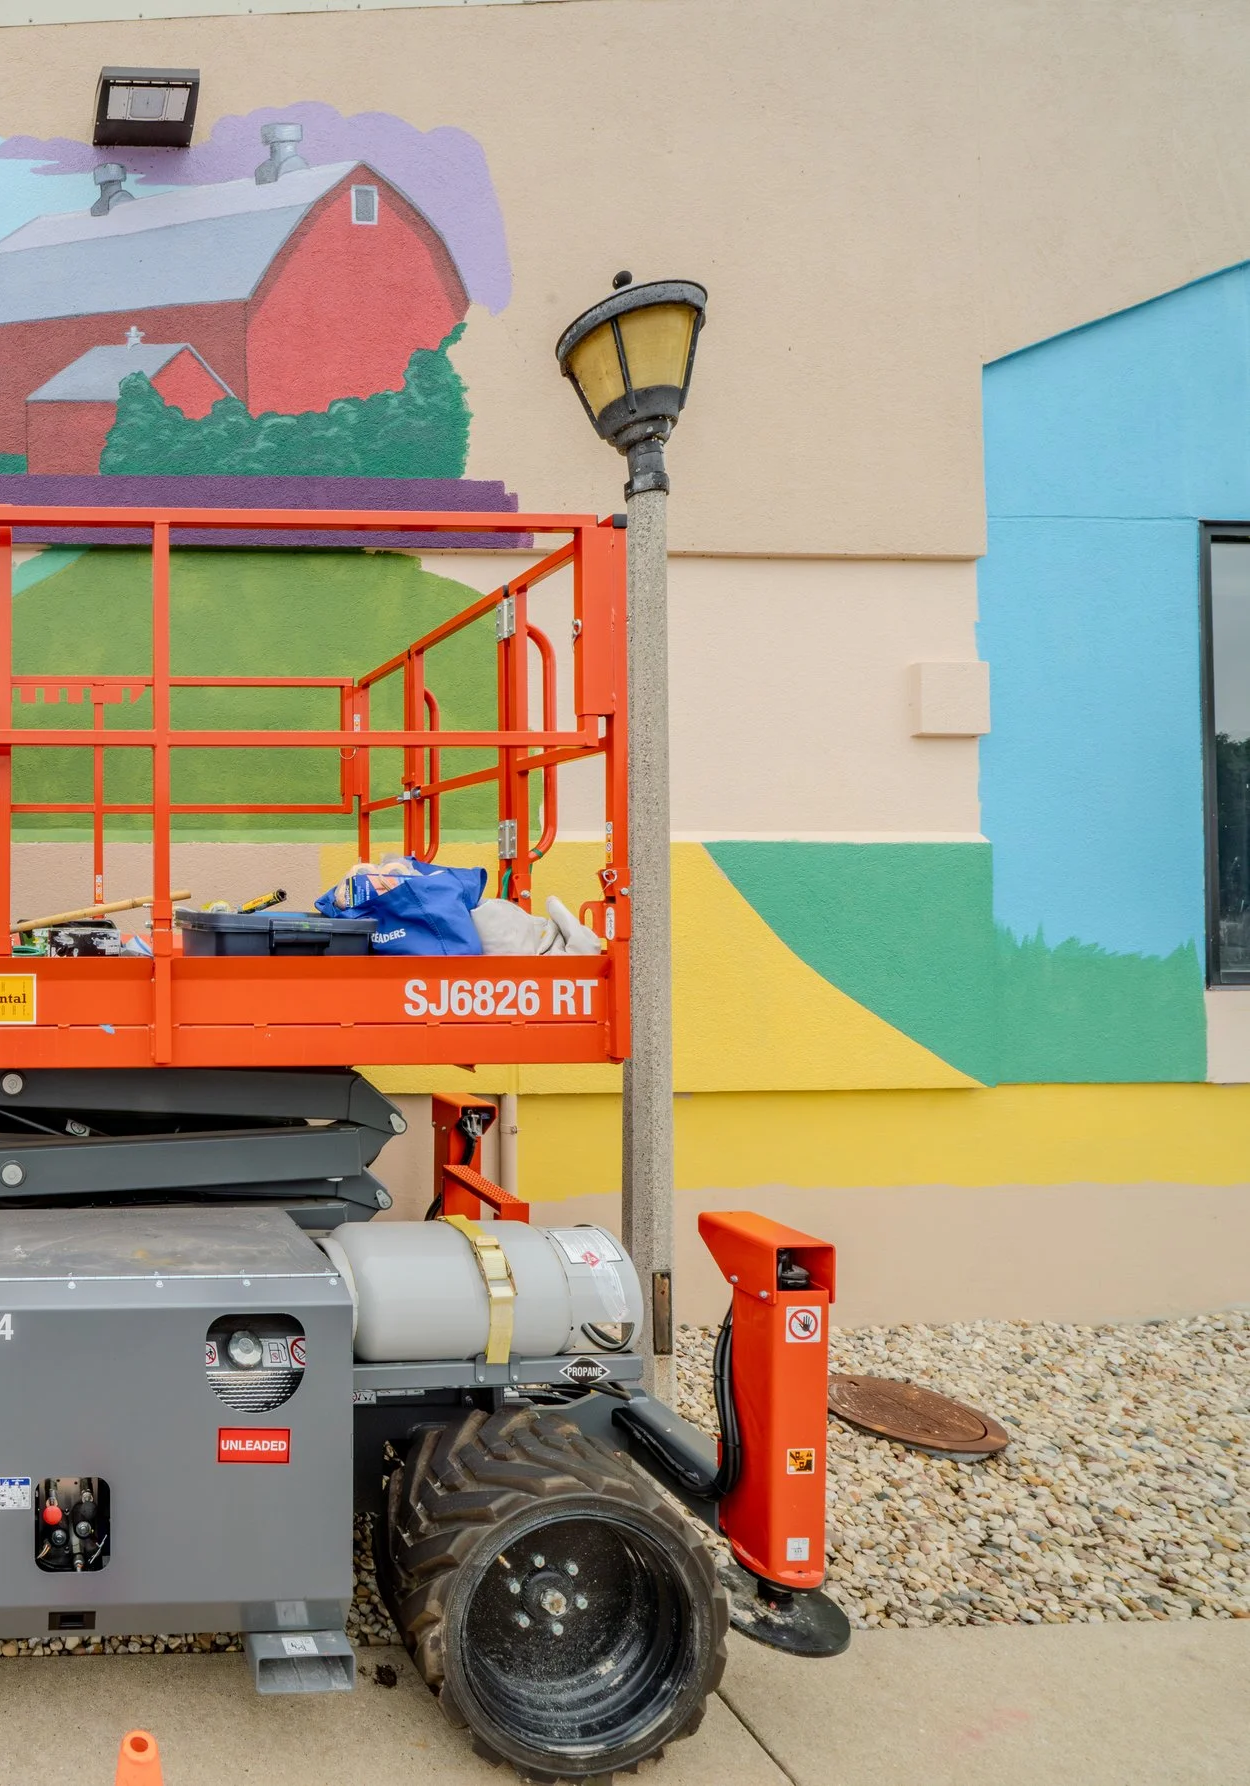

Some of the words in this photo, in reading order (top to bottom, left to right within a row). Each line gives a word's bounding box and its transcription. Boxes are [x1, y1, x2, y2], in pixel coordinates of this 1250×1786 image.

[404, 979, 540, 1016] SJ6826
[552, 979, 598, 1015] RT
[567, 1366, 603, 1377] PROPANE
[221, 1439, 287, 1451] UNLEADED
